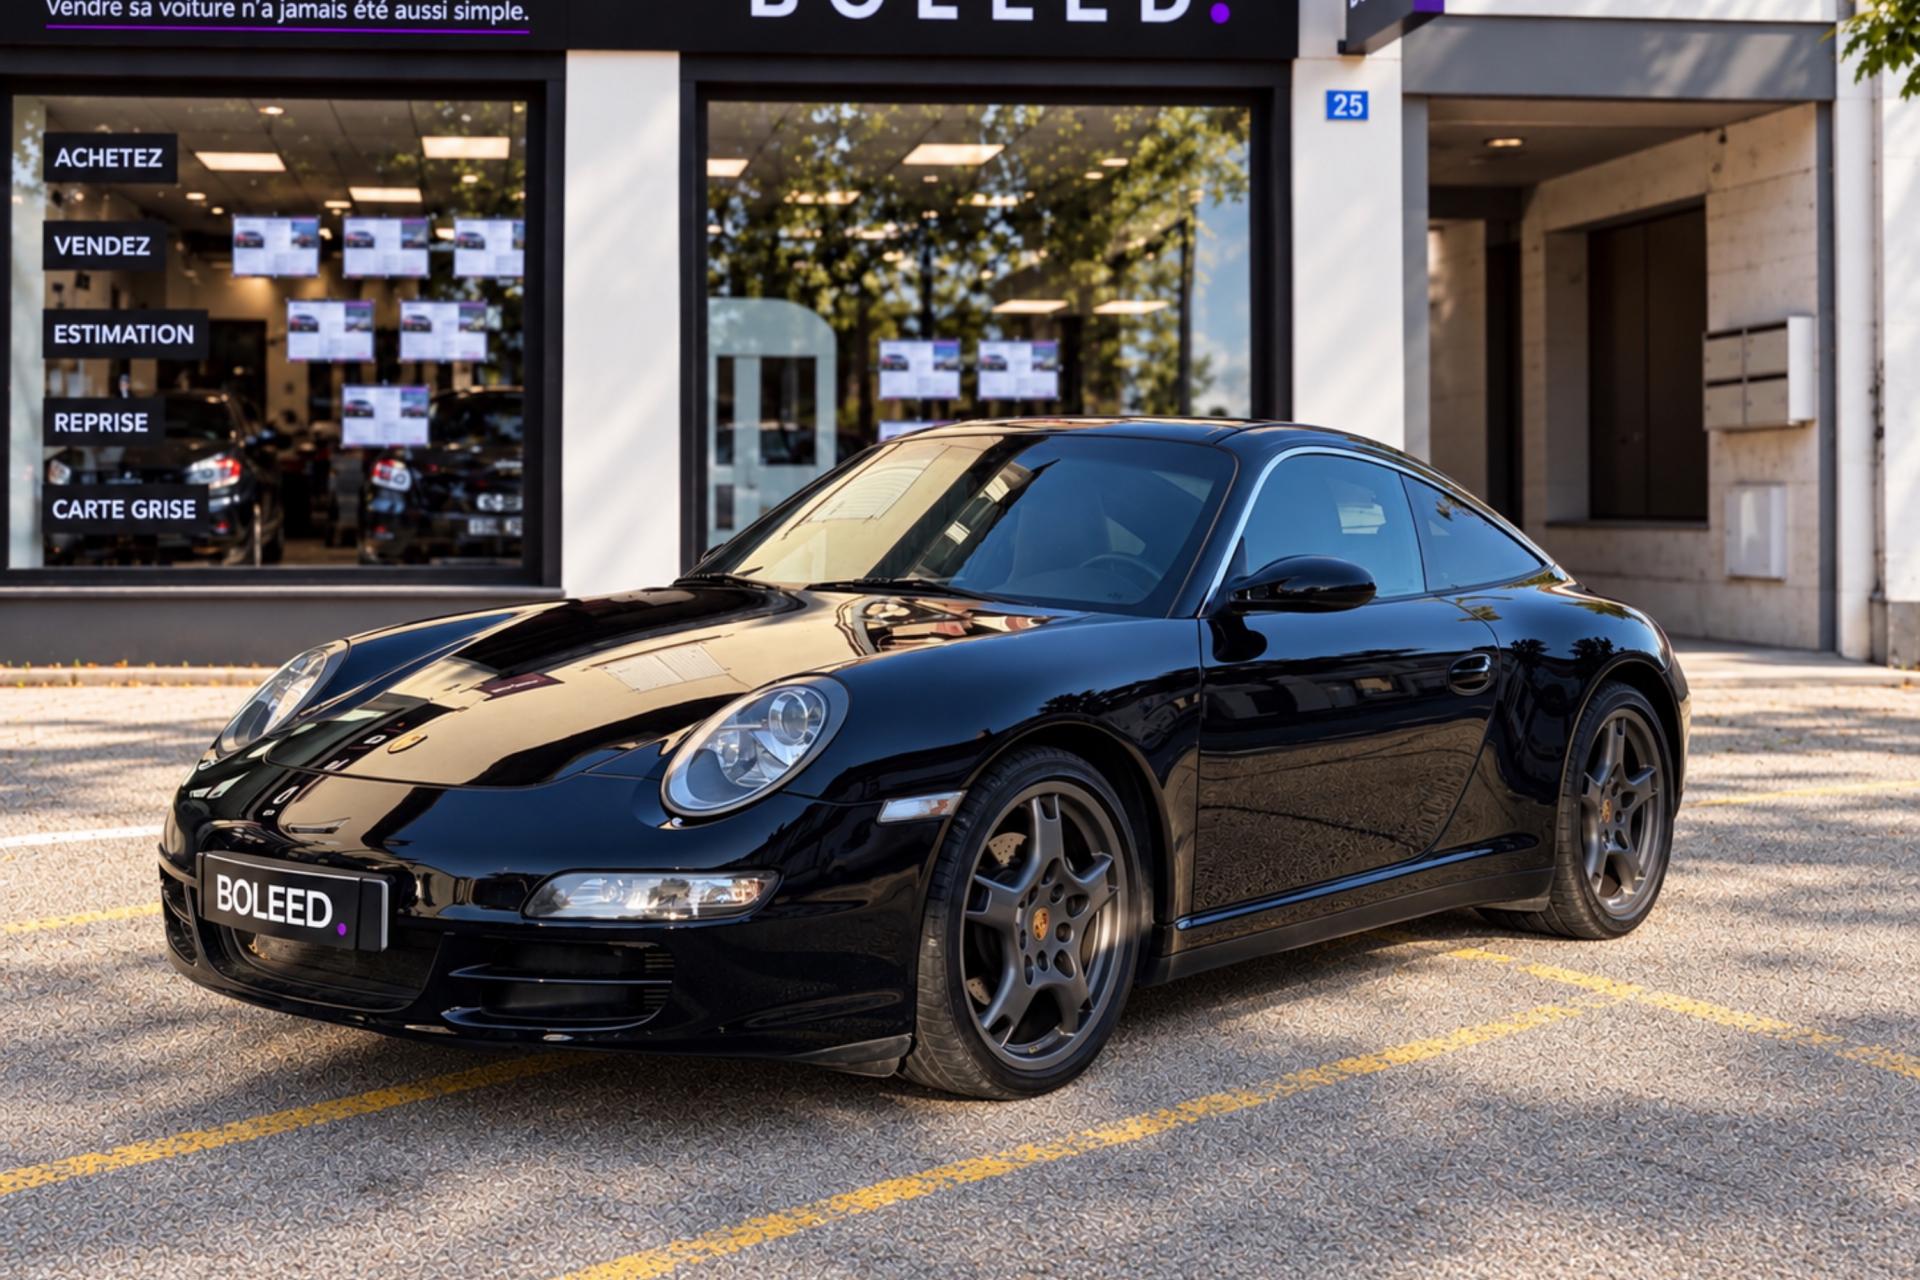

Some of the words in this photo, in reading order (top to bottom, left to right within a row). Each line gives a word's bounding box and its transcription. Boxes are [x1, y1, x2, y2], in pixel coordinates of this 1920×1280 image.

[46, 0, 123, 17] Vendre
[129, 1, 152, 17] sa
[159, 0, 236, 18] voiture
[276, 0, 348, 24] jamais
[353, 0, 389, 20] été
[394, 0, 448, 20] aussi
[453, 0, 529, 25] simple.
[1333, 93, 1363, 117] 25
[54, 147, 164, 168] ACHETEZ
[54, 235, 151, 256] VENDEZ
[53, 323, 195, 345] ESTIMATION
[53, 412, 149, 433] REPRISE
[52, 499, 126, 520] CARTE
[130, 499, 196, 520] GRISE
